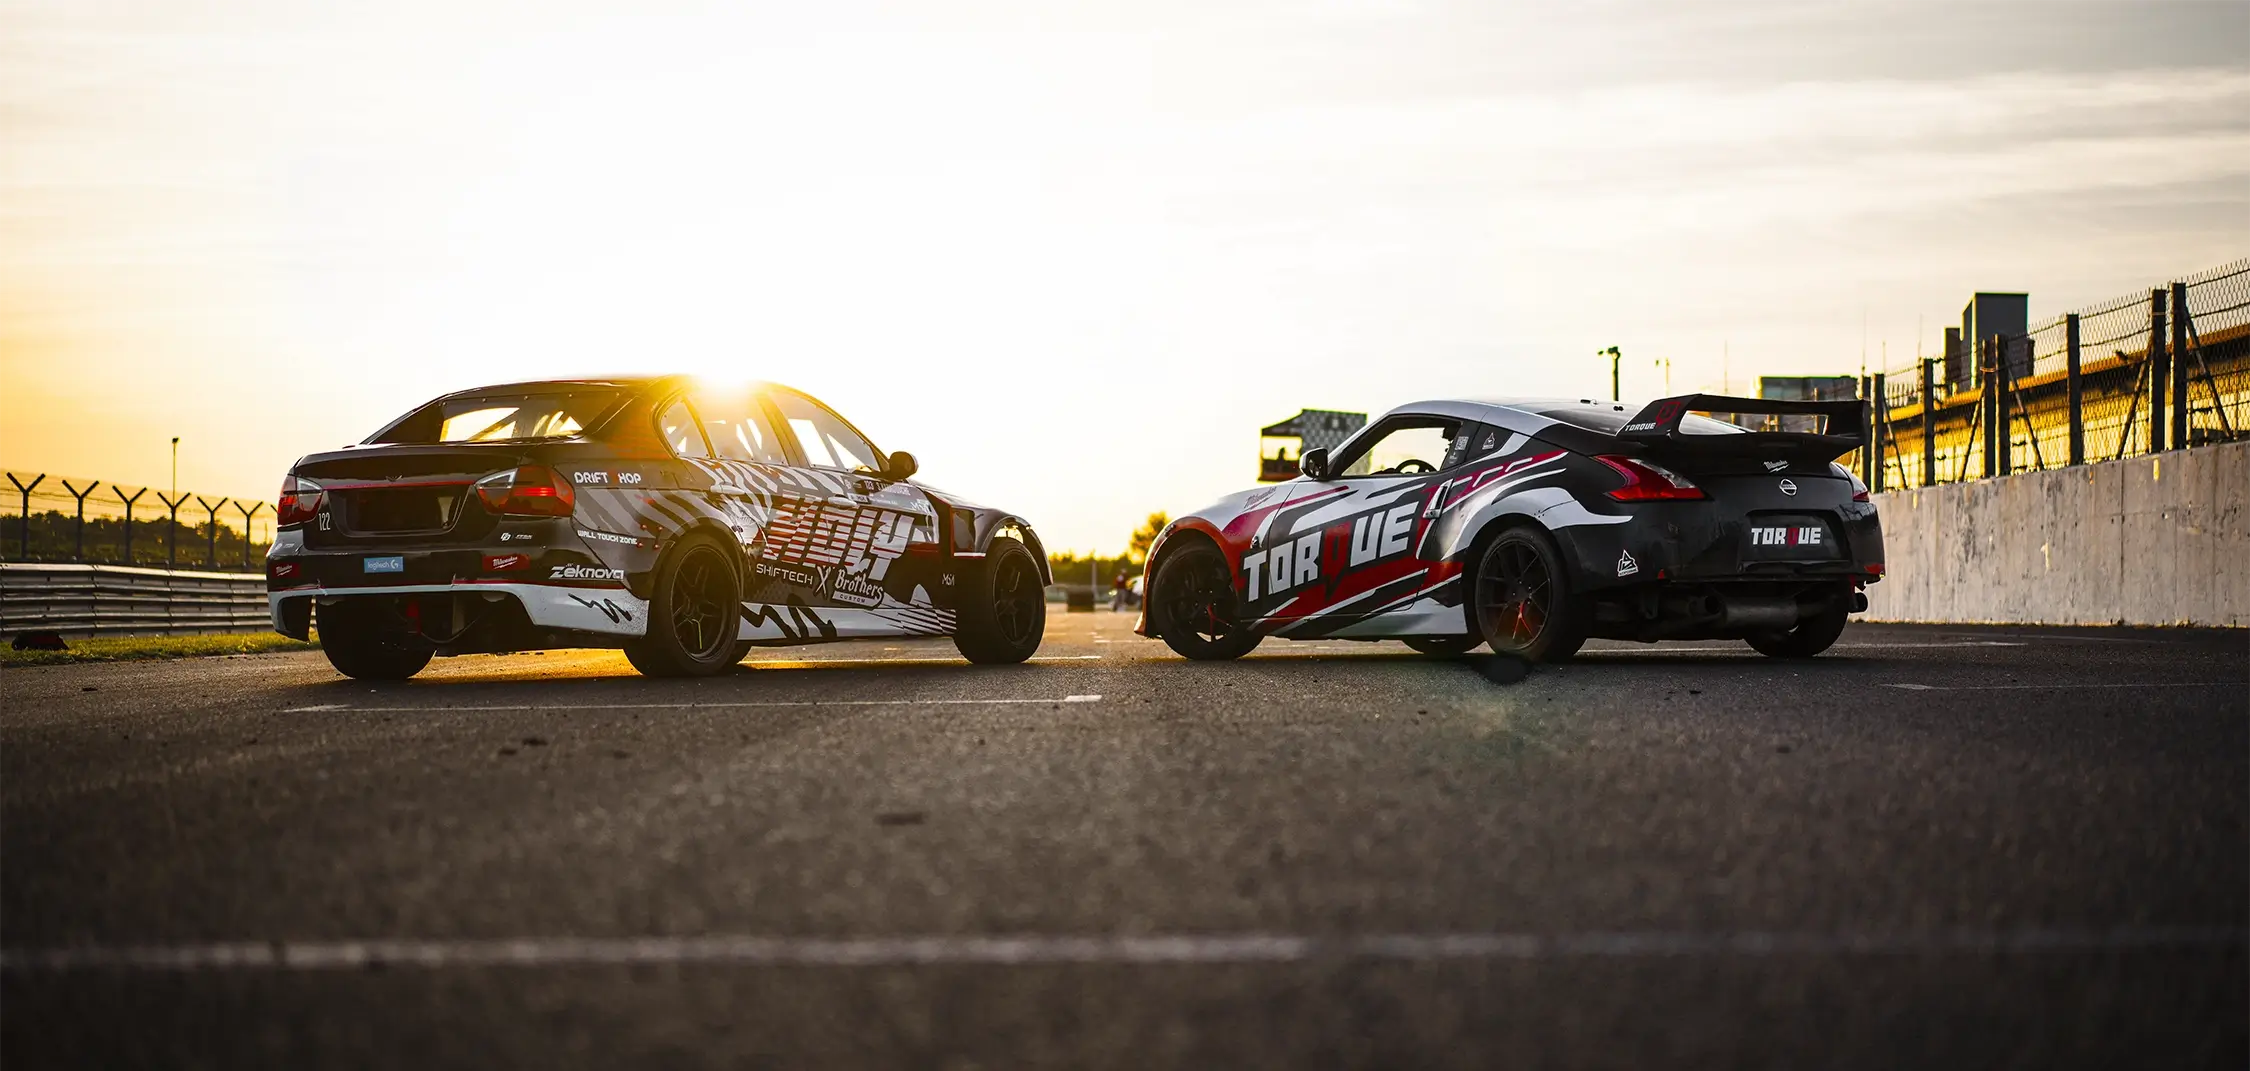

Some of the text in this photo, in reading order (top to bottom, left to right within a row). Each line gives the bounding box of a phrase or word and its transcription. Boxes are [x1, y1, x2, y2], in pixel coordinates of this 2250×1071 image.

[1625, 422, 1656, 432] TORQUE
[574, 472, 608, 483] DRIFT
[318, 512, 331, 531] 122
[577, 530, 596, 539] WALL
[597, 533, 619, 543] TOUCH
[1751, 528, 1821, 546] TORQUE
[1243, 501, 1419, 602] TORQUE
[756, 563, 814, 585] SHIFTECH
[835, 569, 885, 600] Brothers
